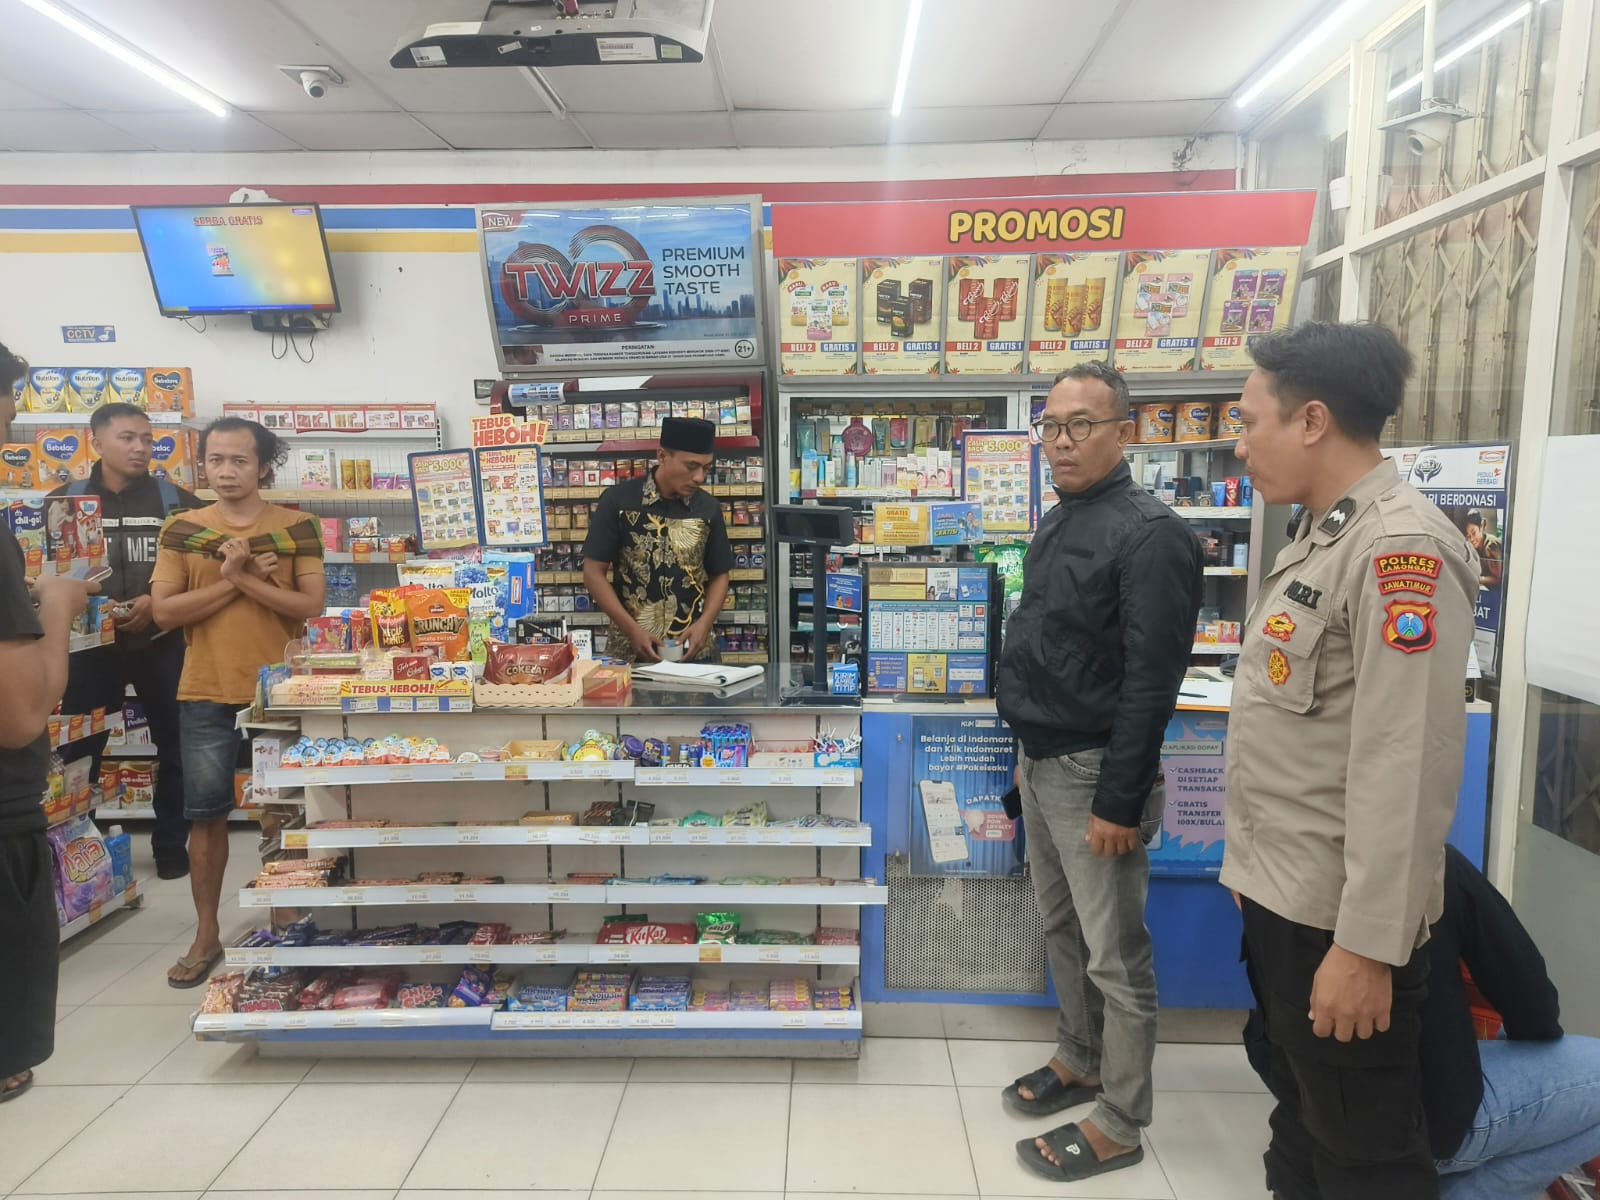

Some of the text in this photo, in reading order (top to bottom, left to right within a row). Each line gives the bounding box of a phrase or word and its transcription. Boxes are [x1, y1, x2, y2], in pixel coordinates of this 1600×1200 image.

[229, 216, 263, 225] GRATIS
[488, 216, 515, 227] NEW
[948, 206, 1125, 243] PROMOSI
[662, 246, 745, 262] PREMIUM
[663, 263, 740, 279] SMOOTH
[505, 260, 657, 300] TWIZZ
[665, 281, 721, 295] TASTE
[568, 313, 623, 324] PRIME
[66, 329, 96, 340] CCTV
[906, 342, 937, 351] GRATIS 1
[956, 342, 978, 351] BELI 2
[989, 341, 1022, 351] GRATIS 1
[1040, 341, 1062, 349] BELI 2
[1073, 340, 1106, 349] GRATIS 1
[1125, 340, 1149, 348] BELI 2
[1160, 339, 1194, 347] GRATIS 1
[1214, 337, 1238, 346] BELI 3
[737, 345, 751, 353] 21+
[791, 344, 807, 352] BELI
[823, 343, 855, 352] GRATIS 1
[873, 343, 896, 351] BELI 2
[472, 417, 511, 430] TEBUS
[474, 424, 546, 446] HEBOH!
[46, 443, 74, 452] Bebelac
[988, 440, 1023, 451] 5.000
[433, 458, 464, 472] 5.000
[1425, 494, 1496, 506] ARI BERDONASI
[127, 537, 159, 562] ME
[1379, 556, 1436, 569] POLRES
[1382, 564, 1433, 574] LAMONGAN
[1383, 581, 1431, 592] JAWA TIMUR
[352, 684, 434, 694] TEBUS HEBOH!
[921, 735, 955, 744] Belanja
[630, 927, 665, 944] KitKat
